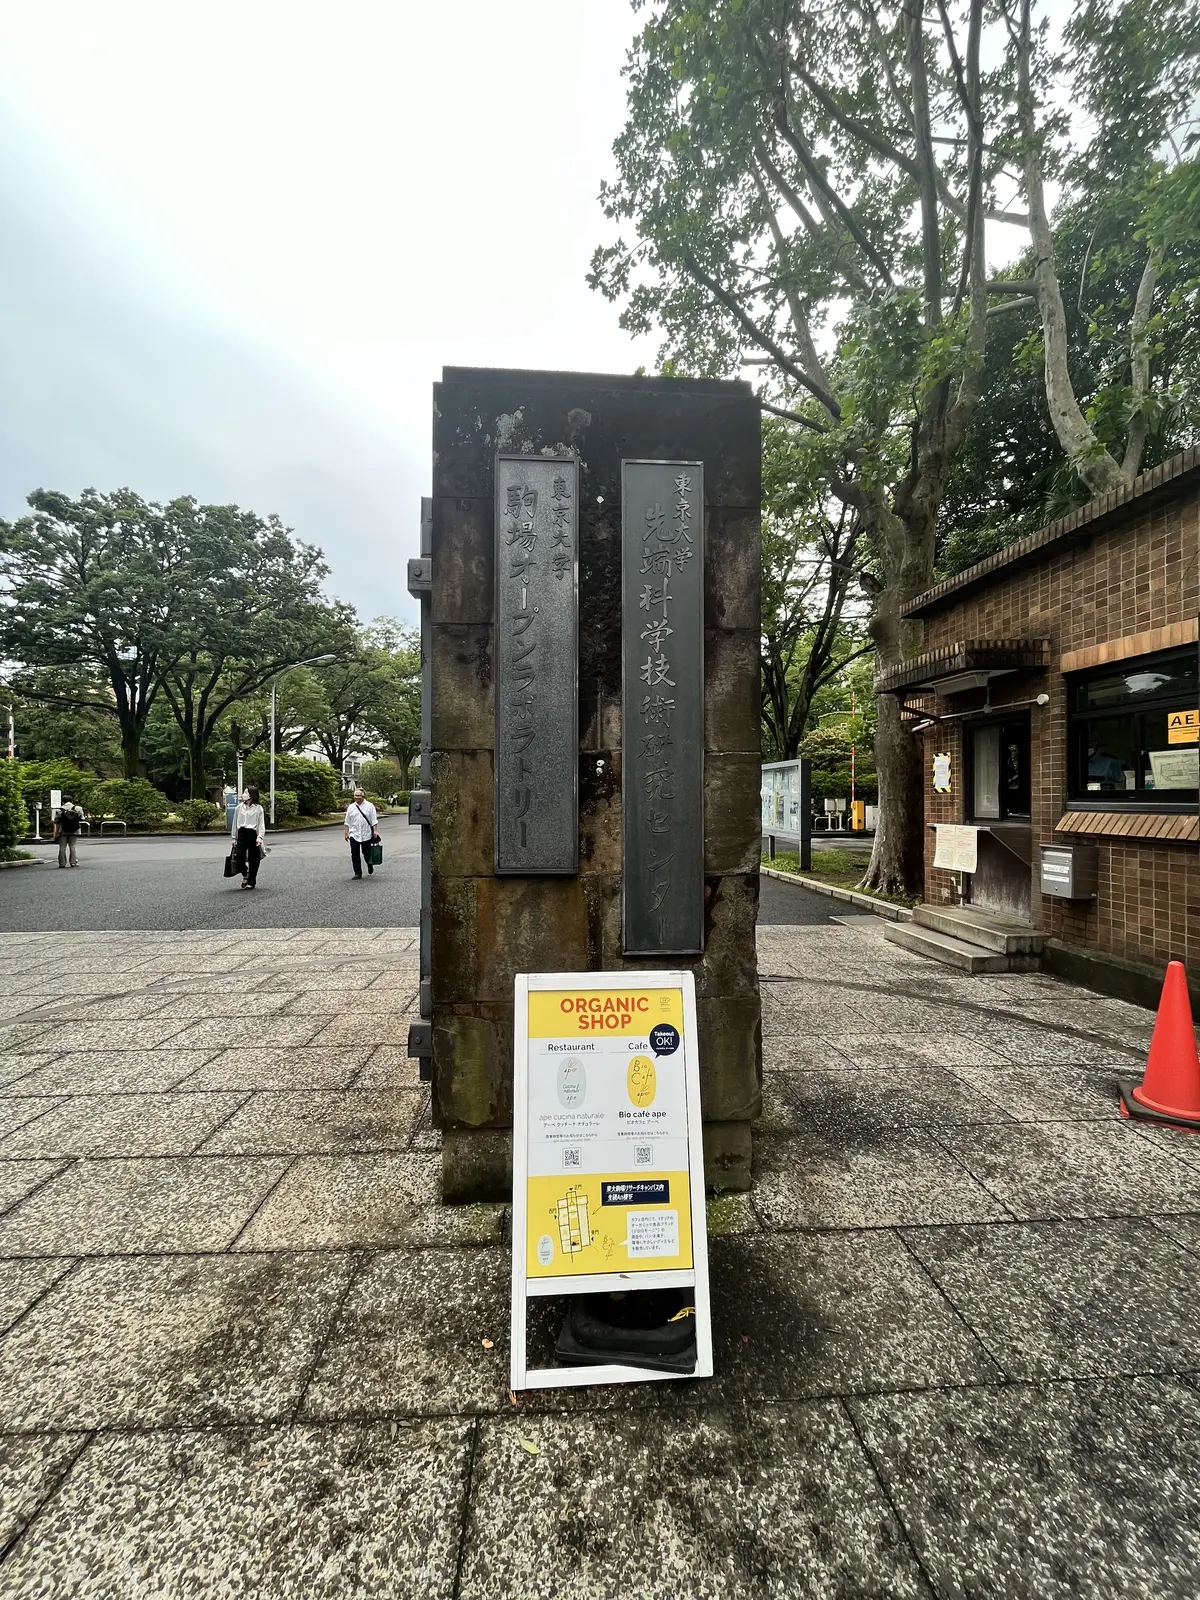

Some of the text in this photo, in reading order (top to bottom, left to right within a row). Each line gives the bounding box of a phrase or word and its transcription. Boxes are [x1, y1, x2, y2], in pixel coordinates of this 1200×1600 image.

[550, 475, 572, 581] 東京大学
[670, 471, 694, 573] 東京大学
[503, 483, 540, 848] 駒場オープンラボラトリー
[637, 502, 677, 945] 先端科学技術研究センター
[1170, 714, 1200, 727] AE
[560, 997, 650, 1013] ORGANIC
[578, 1014, 632, 1030] SHOP
[547, 1043, 595, 1052] Restaurant
[628, 1041, 649, 1051] Cafe
[656, 1037, 673, 1046] OK!
[539, 1112, 605, 1122] ape cucina naturale
[651, 1111, 667, 1119] ape
